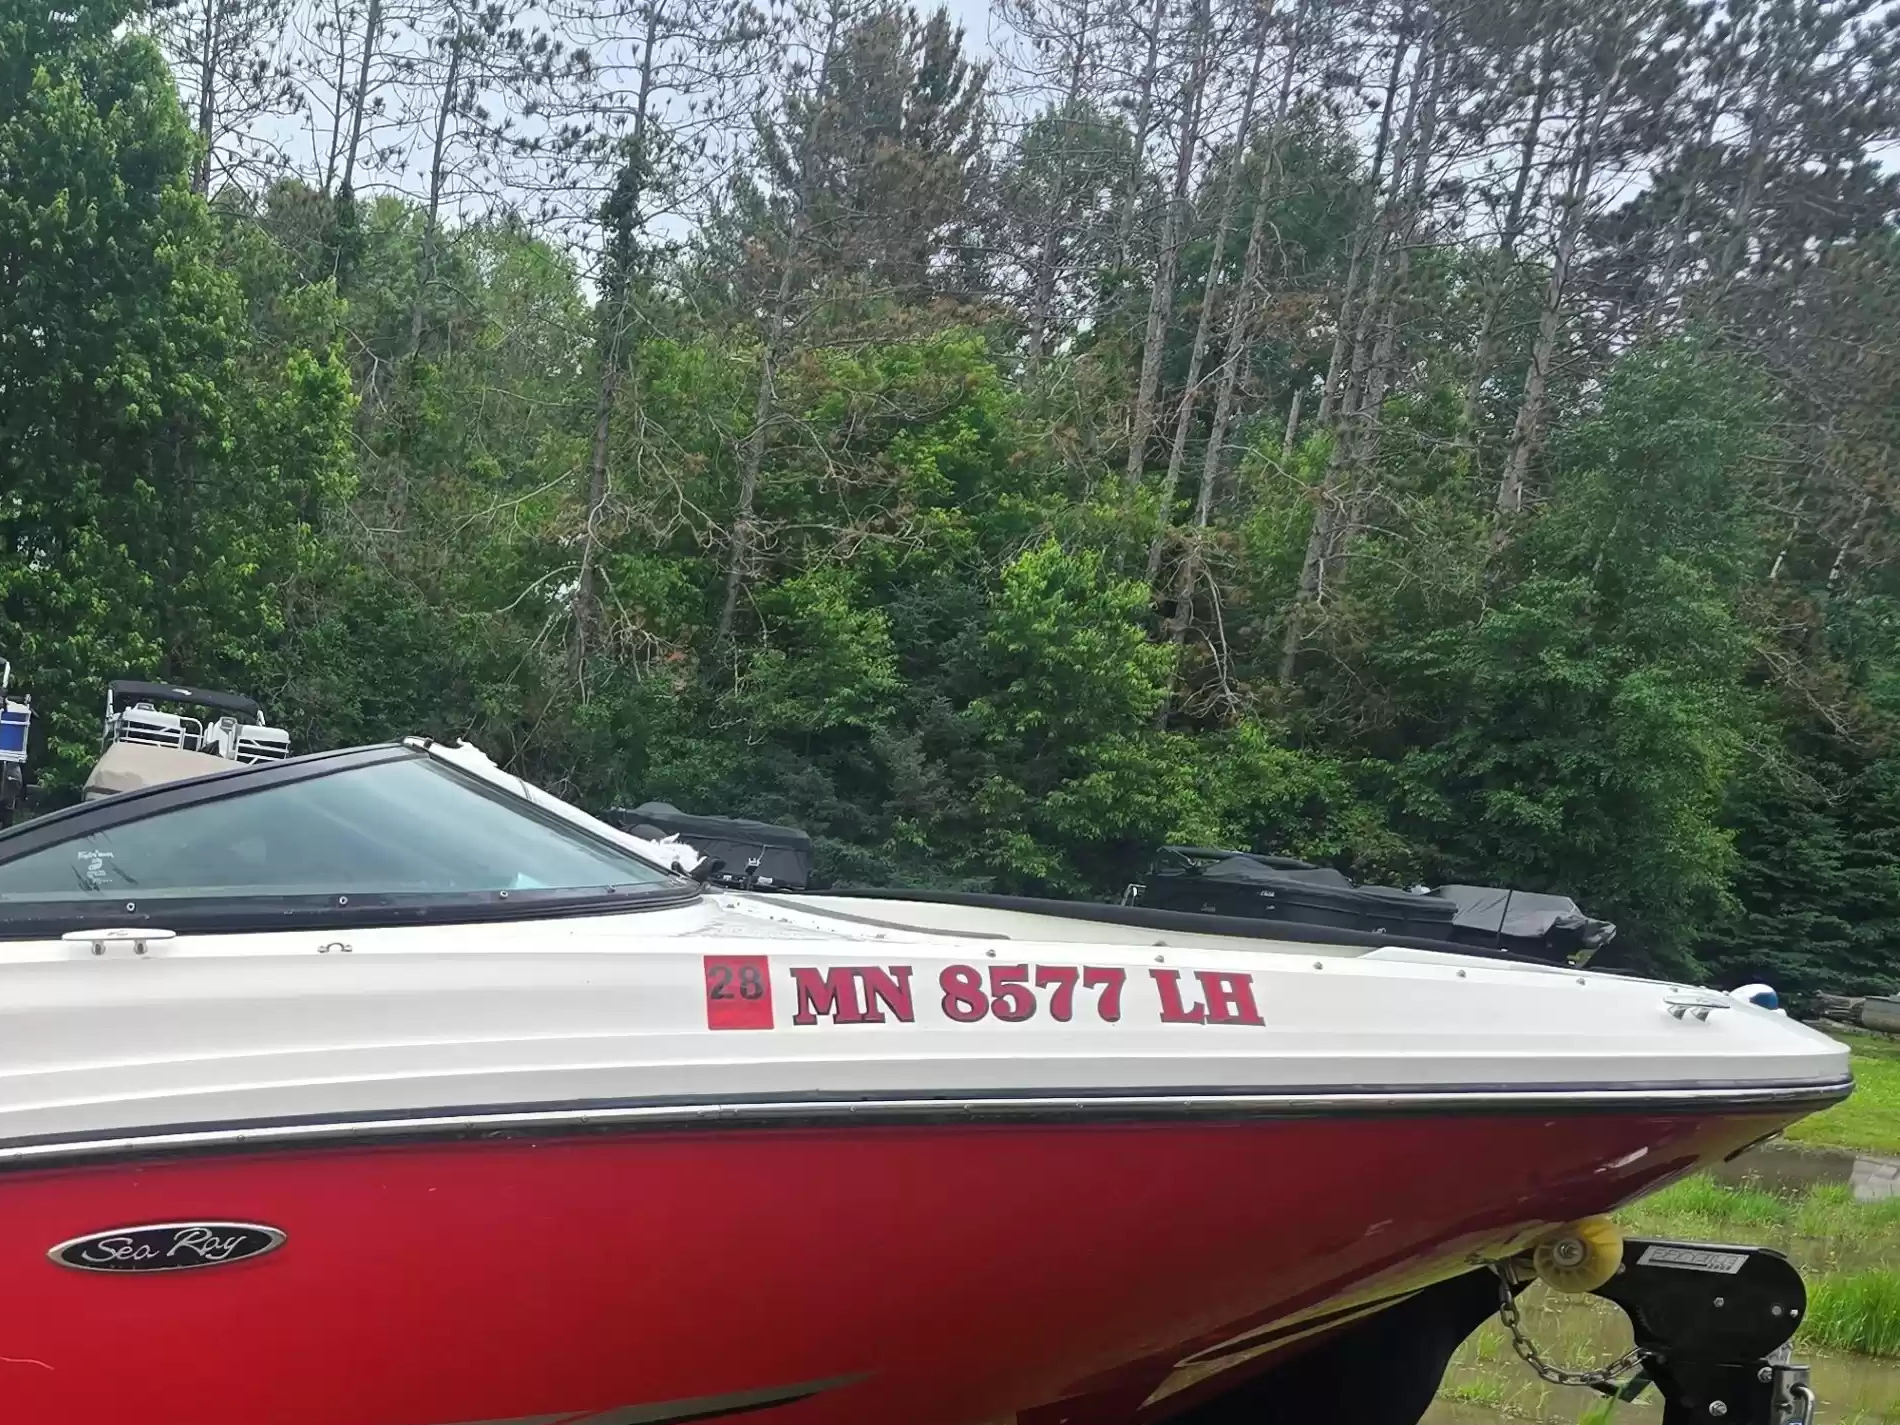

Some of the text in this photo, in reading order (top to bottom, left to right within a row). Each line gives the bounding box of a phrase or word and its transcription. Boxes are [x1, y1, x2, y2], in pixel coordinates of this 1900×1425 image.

[708, 963, 765, 1000] 28
[789, 963, 1266, 1027] MN 8577 LH
[81, 1227, 248, 1262] Sea Ray
